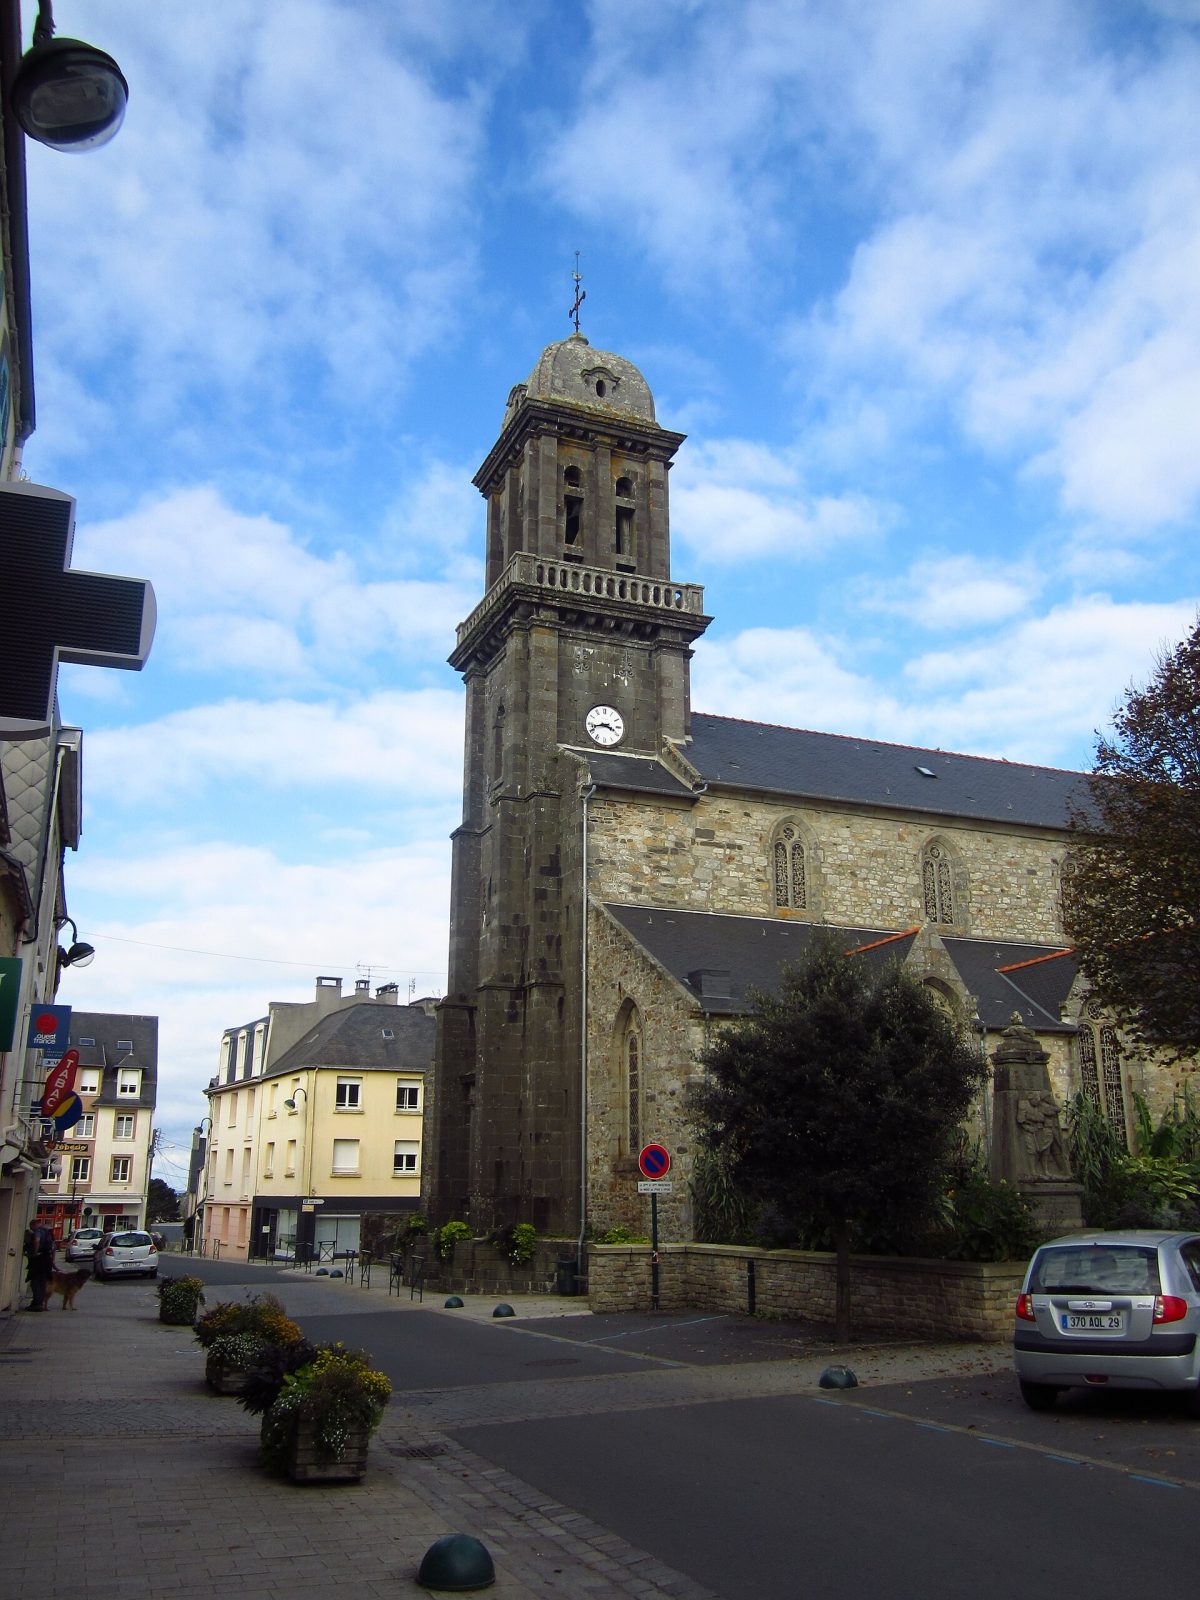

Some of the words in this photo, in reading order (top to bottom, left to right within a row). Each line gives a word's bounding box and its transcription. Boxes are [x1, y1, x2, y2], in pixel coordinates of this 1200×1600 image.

[46, 1059, 74, 1107] TABAC
[1070, 1316, 1086, 1328] 370
[1089, 1316, 1105, 1328] AQL
[1108, 1316, 1120, 1328] 29
